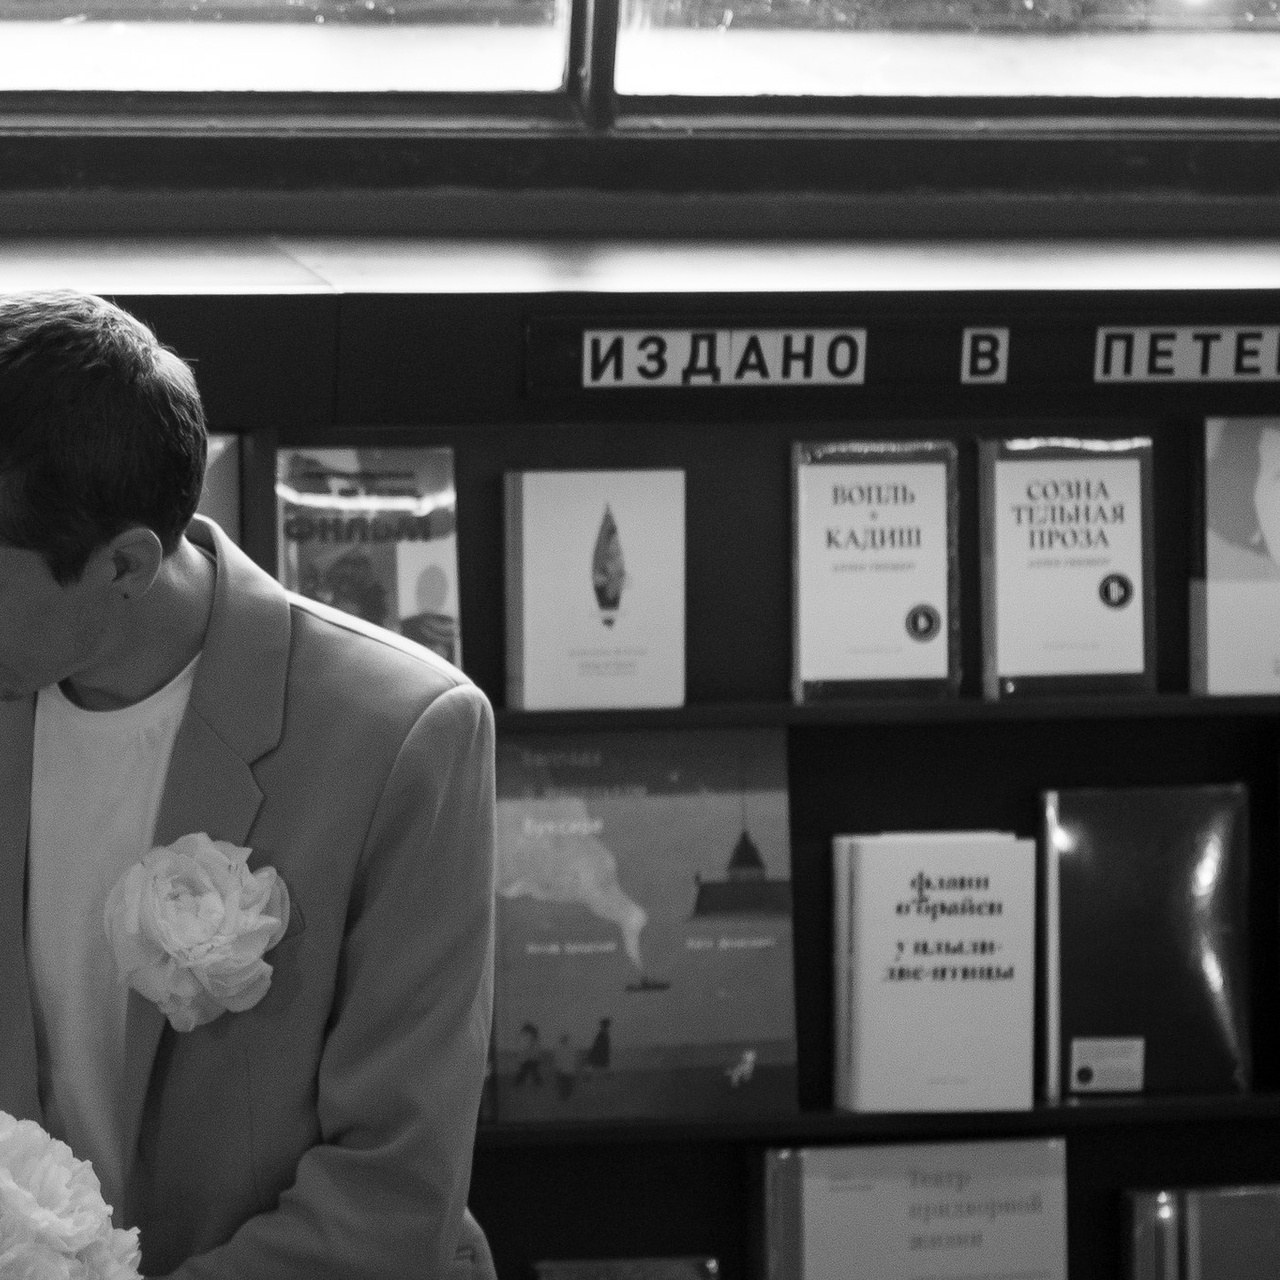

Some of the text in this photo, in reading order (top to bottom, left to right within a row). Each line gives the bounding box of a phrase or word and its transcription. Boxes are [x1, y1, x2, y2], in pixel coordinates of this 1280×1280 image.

[590, 331, 1280, 386] ИЗДАНО В ПЕТЕ
[831, 484, 916, 508] ВОПЛЬ
[1026, 479, 1111, 503] СОЗНА
[1012, 503, 1126, 528] ТЕЛЬНАЯ
[825, 526, 922, 552] КАДИШ
[1028, 527, 1111, 551] ПРОЗА
